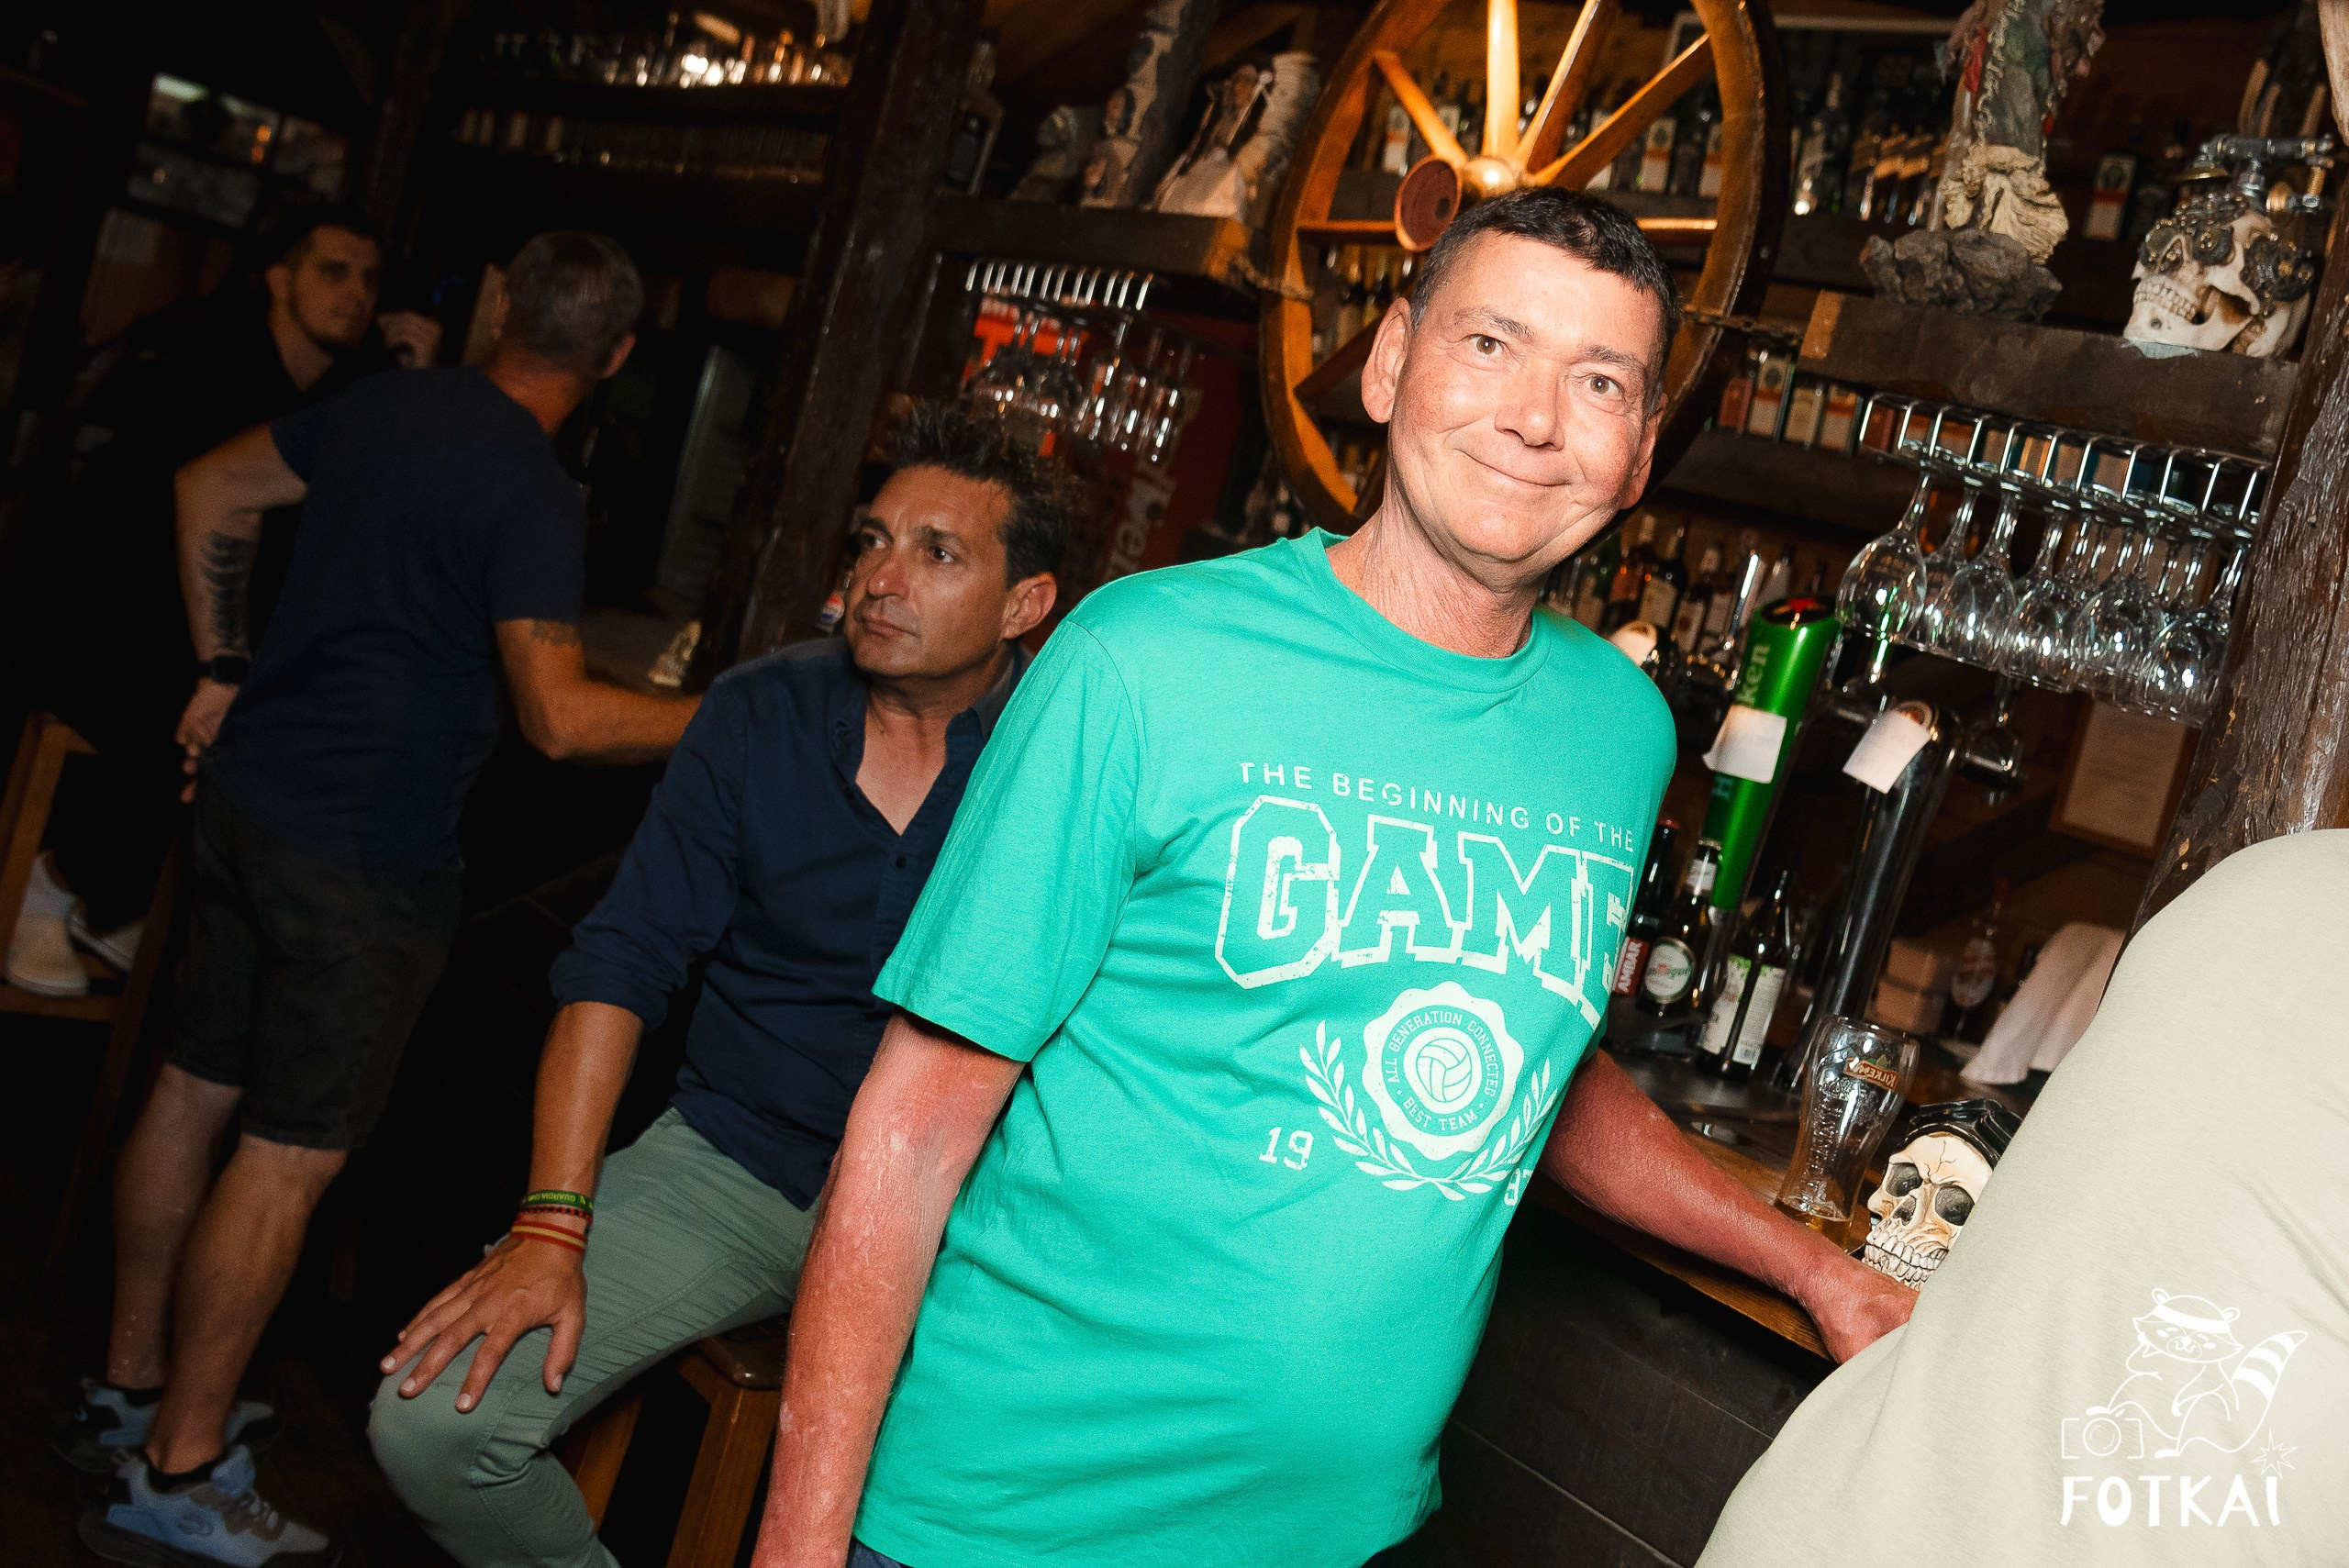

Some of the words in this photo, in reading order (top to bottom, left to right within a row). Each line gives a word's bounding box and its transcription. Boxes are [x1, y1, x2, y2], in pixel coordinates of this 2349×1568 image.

[1236, 762, 1312, 790] THE
[1332, 772, 1530, 829] BEGINNING
[1545, 812, 1581, 838] OF
[1594, 820, 1634, 852] THE
[1617, 940, 1642, 993] AMBAR
[1388, 1010, 1463, 1052] GENERATION
[1385, 1057, 1400, 1084] ALL
[1466, 1019, 1499, 1097] CONNECTED
[1403, 1096, 1432, 1128] BEST
[1438, 1108, 1478, 1131] TEAM
[1258, 1126, 1315, 1172] 19
[541, 1193, 576, 1203] GUARDIA
